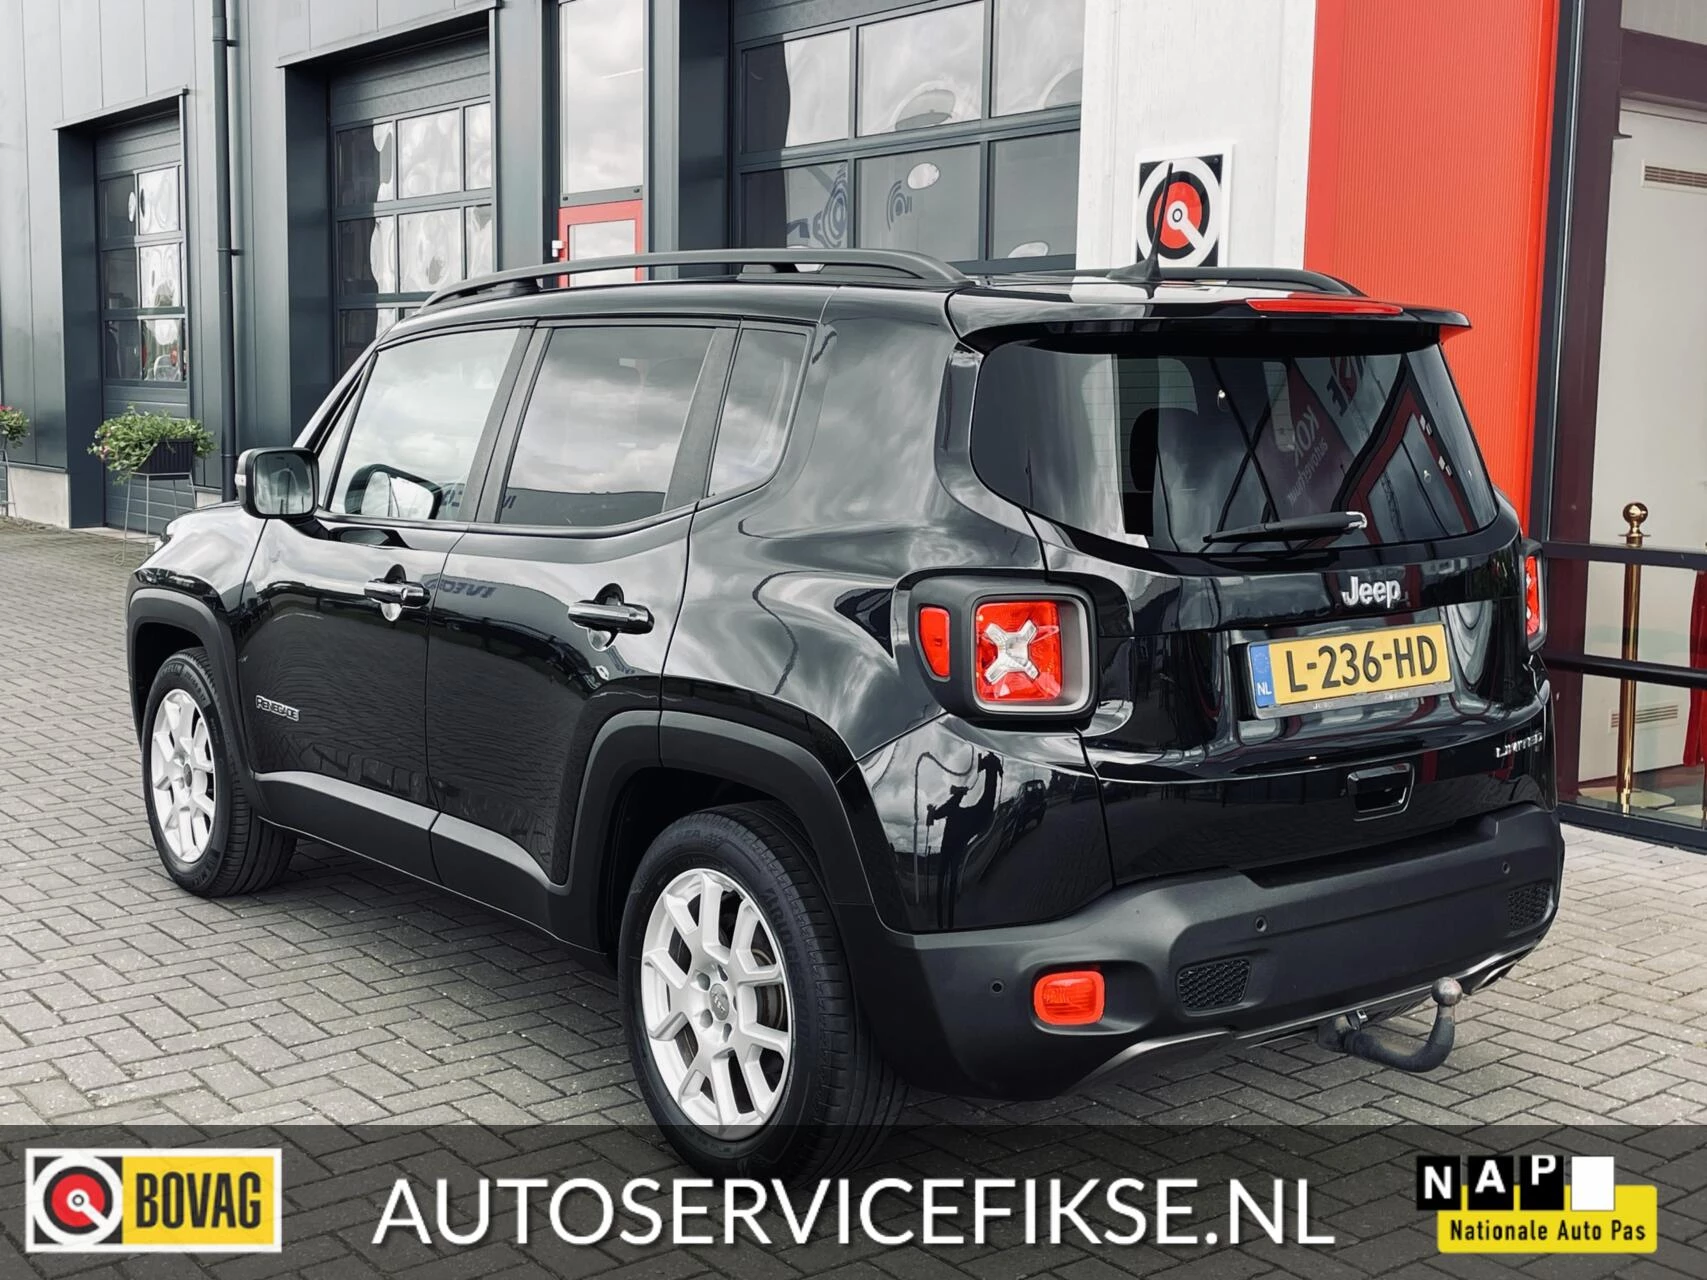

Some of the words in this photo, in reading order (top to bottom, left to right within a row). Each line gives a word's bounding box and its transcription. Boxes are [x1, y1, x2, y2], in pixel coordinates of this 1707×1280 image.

[1342, 575, 1400, 609] Jeep
[1285, 634, 1438, 693] L-236-HD
[1256, 681, 1273, 697] NL
[256, 694, 299, 722] RENEGADE
